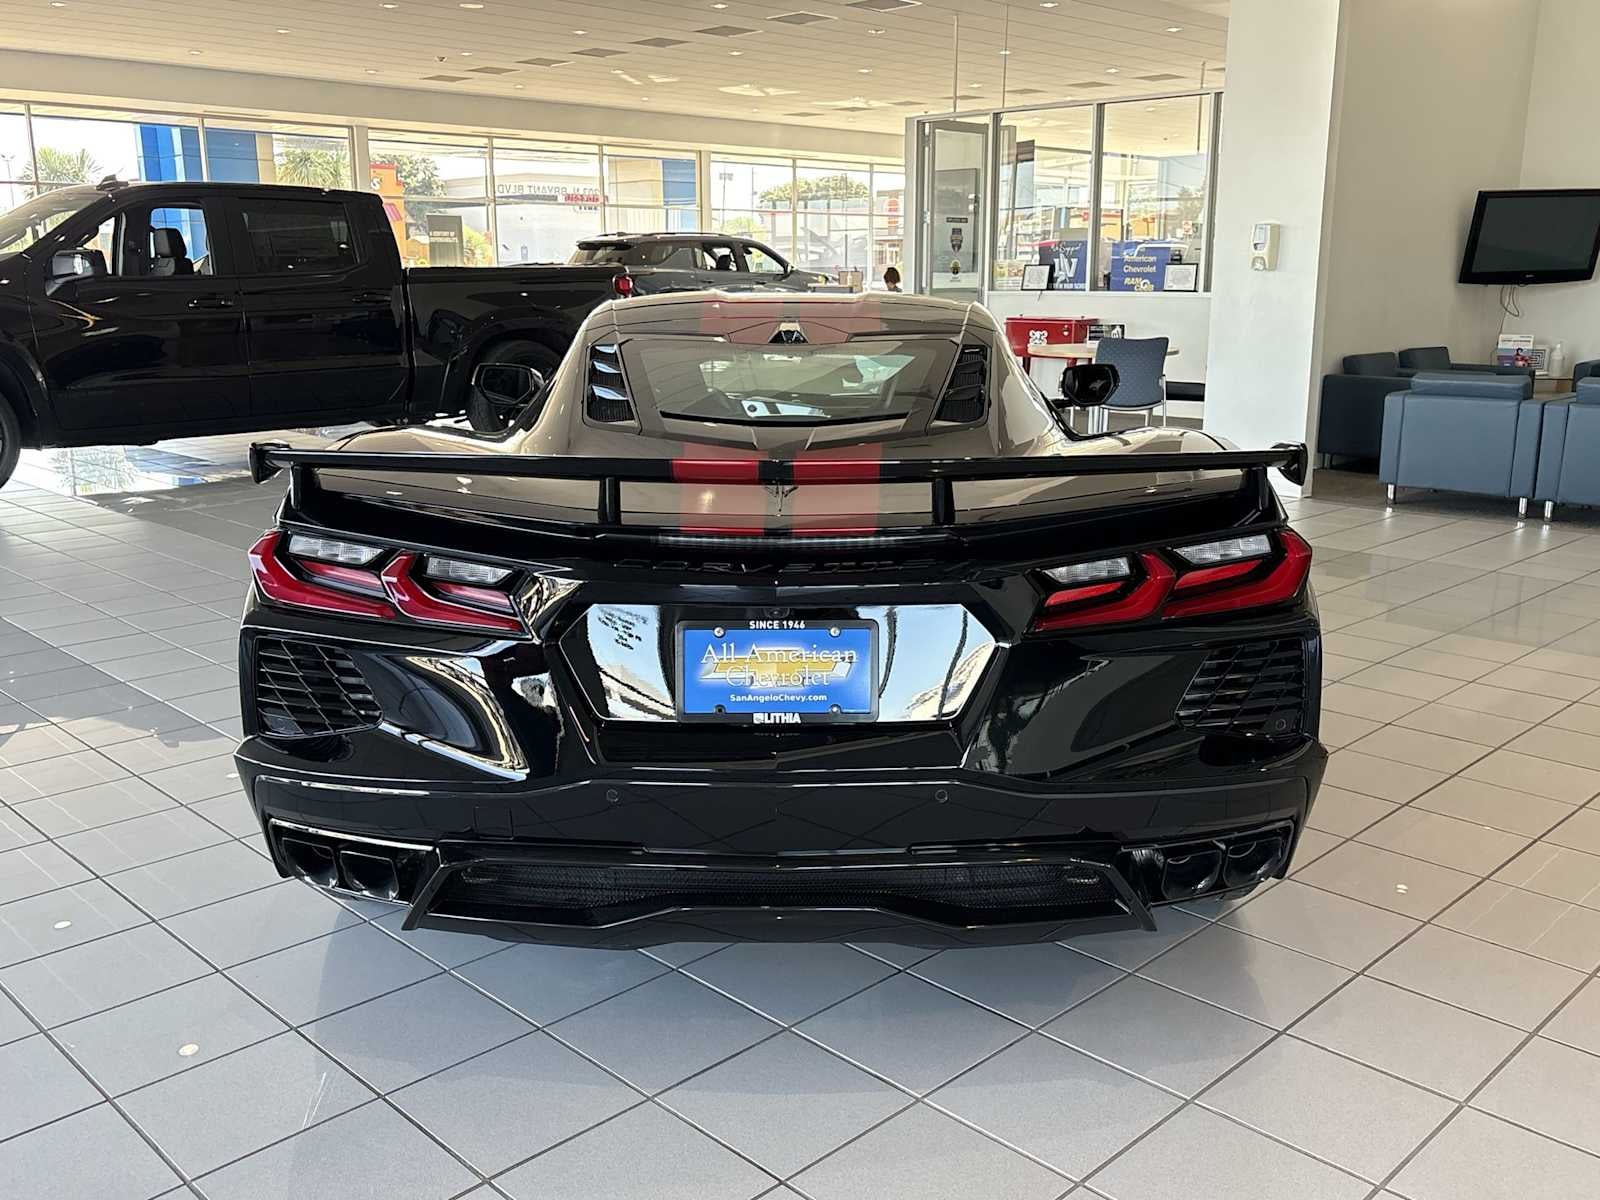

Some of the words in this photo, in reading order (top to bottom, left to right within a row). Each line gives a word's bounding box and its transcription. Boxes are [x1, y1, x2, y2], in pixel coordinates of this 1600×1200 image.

[1123, 265, 1157, 273] Chevrolet
[749, 620, 780, 629] SINCE
[782, 620, 806, 629] 1946
[701, 643, 736, 663] All
[746, 641, 858, 664] American
[726, 665, 831, 687] Chevrolet
[730, 694, 828, 703] SanAngeloChevy.com
[764, 712, 802, 724] LITHIA
